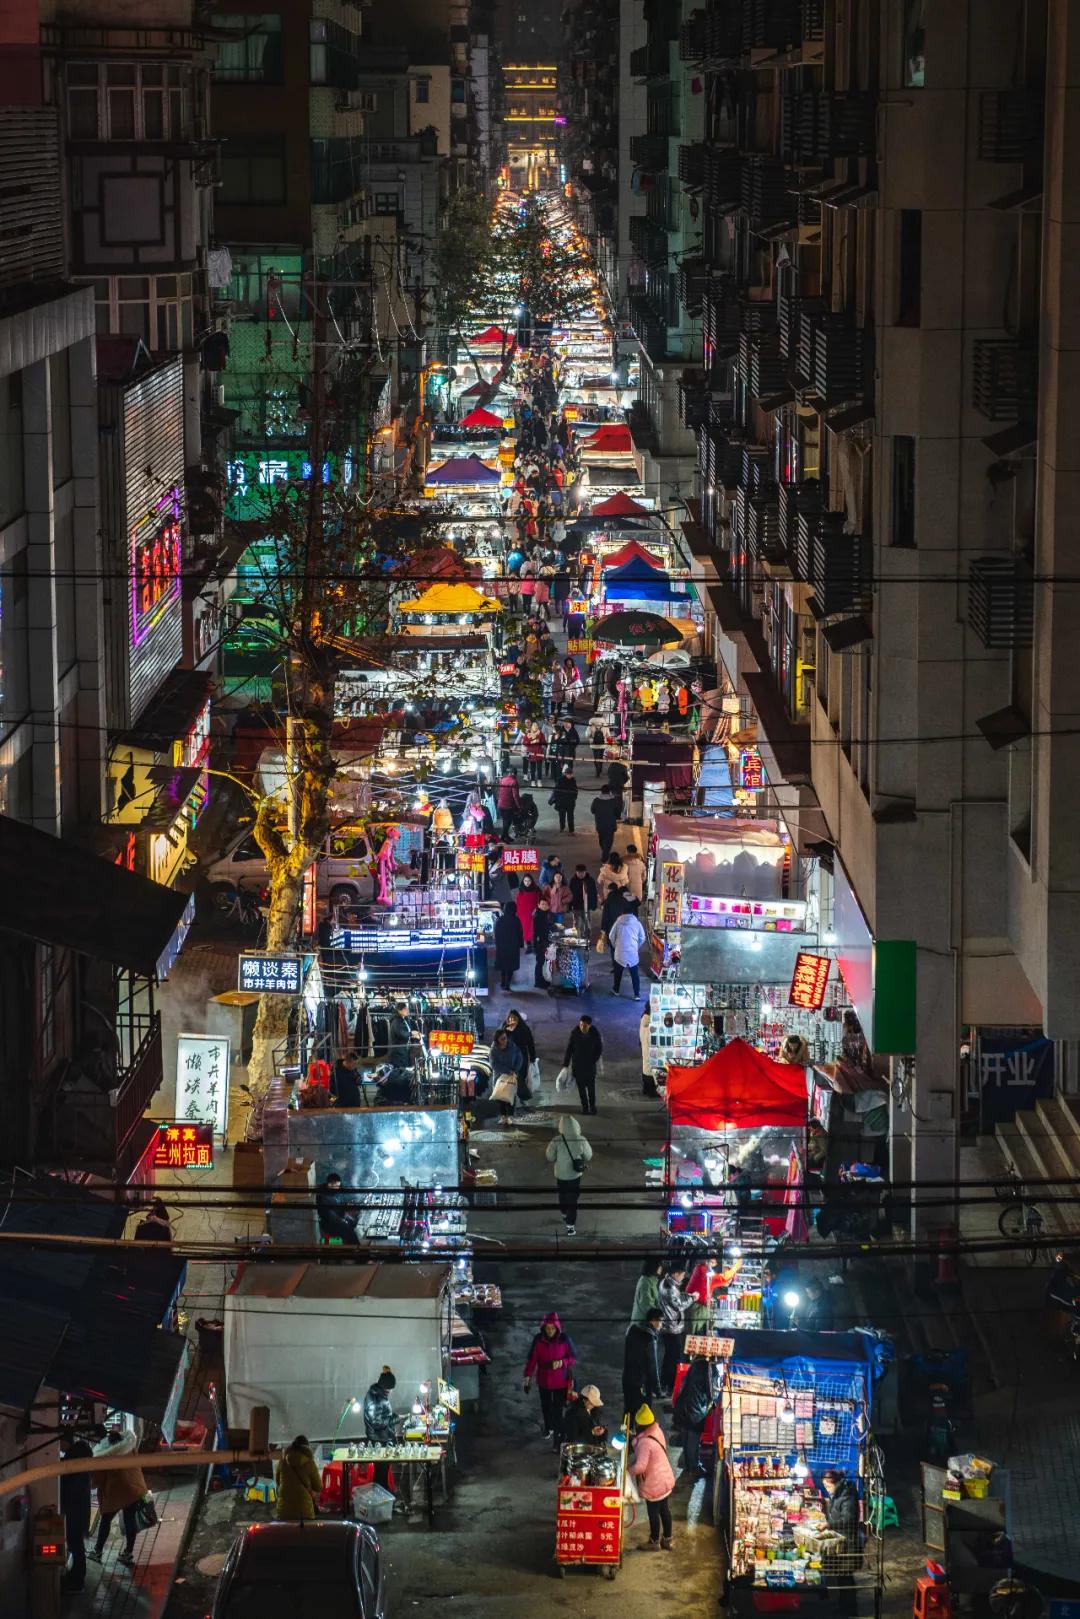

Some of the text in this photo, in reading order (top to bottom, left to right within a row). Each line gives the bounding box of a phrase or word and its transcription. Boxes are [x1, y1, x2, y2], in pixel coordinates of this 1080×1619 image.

[504, 850, 537, 864] 贴膜
[664, 866, 680, 924] 化妆品
[243, 979, 298, 990] 市井羊肉馆
[981, 1052, 1036, 1087] 开业
[167, 1128, 196, 1141] 清真
[155, 1143, 210, 1166] 兰州拉面
